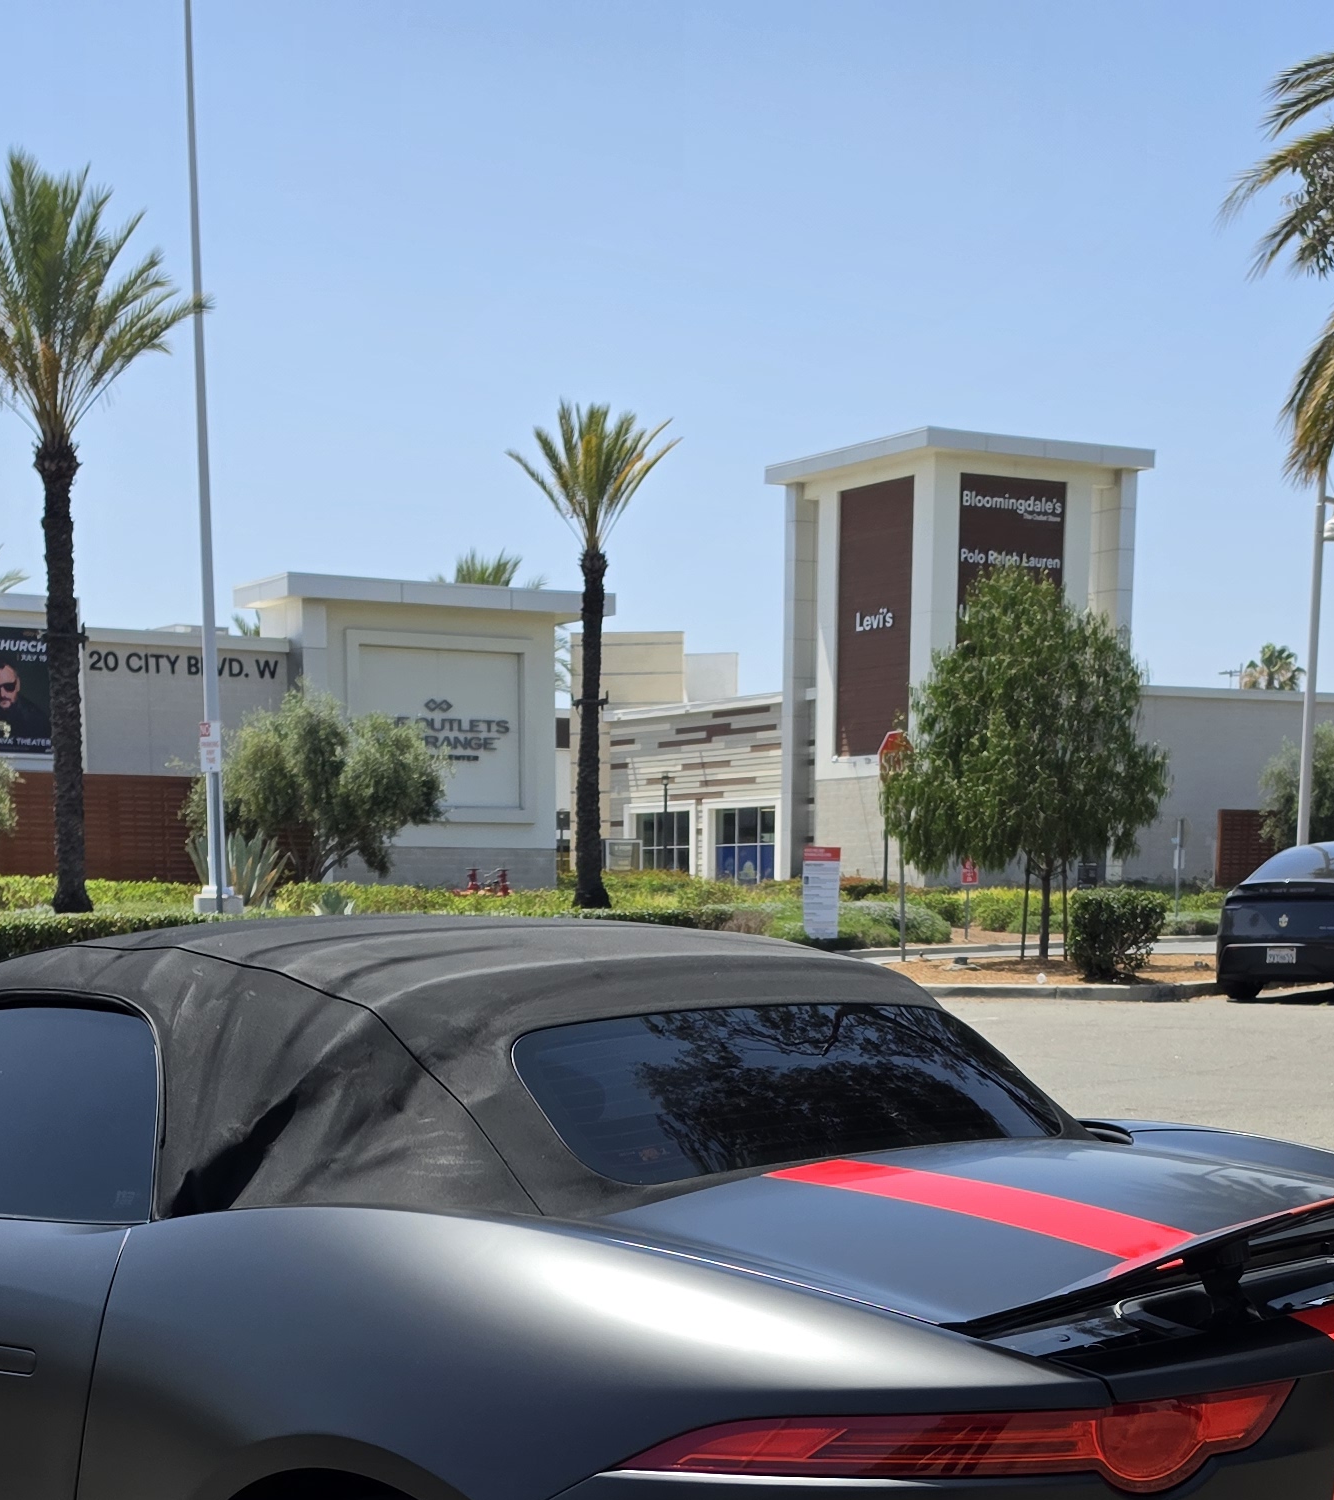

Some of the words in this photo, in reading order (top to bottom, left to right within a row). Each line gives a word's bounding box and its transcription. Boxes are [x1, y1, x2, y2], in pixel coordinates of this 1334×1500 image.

[962, 490, 1062, 514] Bloomingdale's
[960, 548, 986, 563] Polo
[988, 550, 1020, 568] Ralph
[1022, 552, 1060, 568] Lauren
[856, 608, 893, 632] Levi's
[89, 651, 119, 672] 20
[125, 653, 180, 675] CITY
[187, 656, 249, 678] BVD.
[255, 659, 279, 679] W
[16, 737, 52, 746] THEATER
[423, 735, 501, 751] RANGE
[448, 754, 479, 762] ENTER
